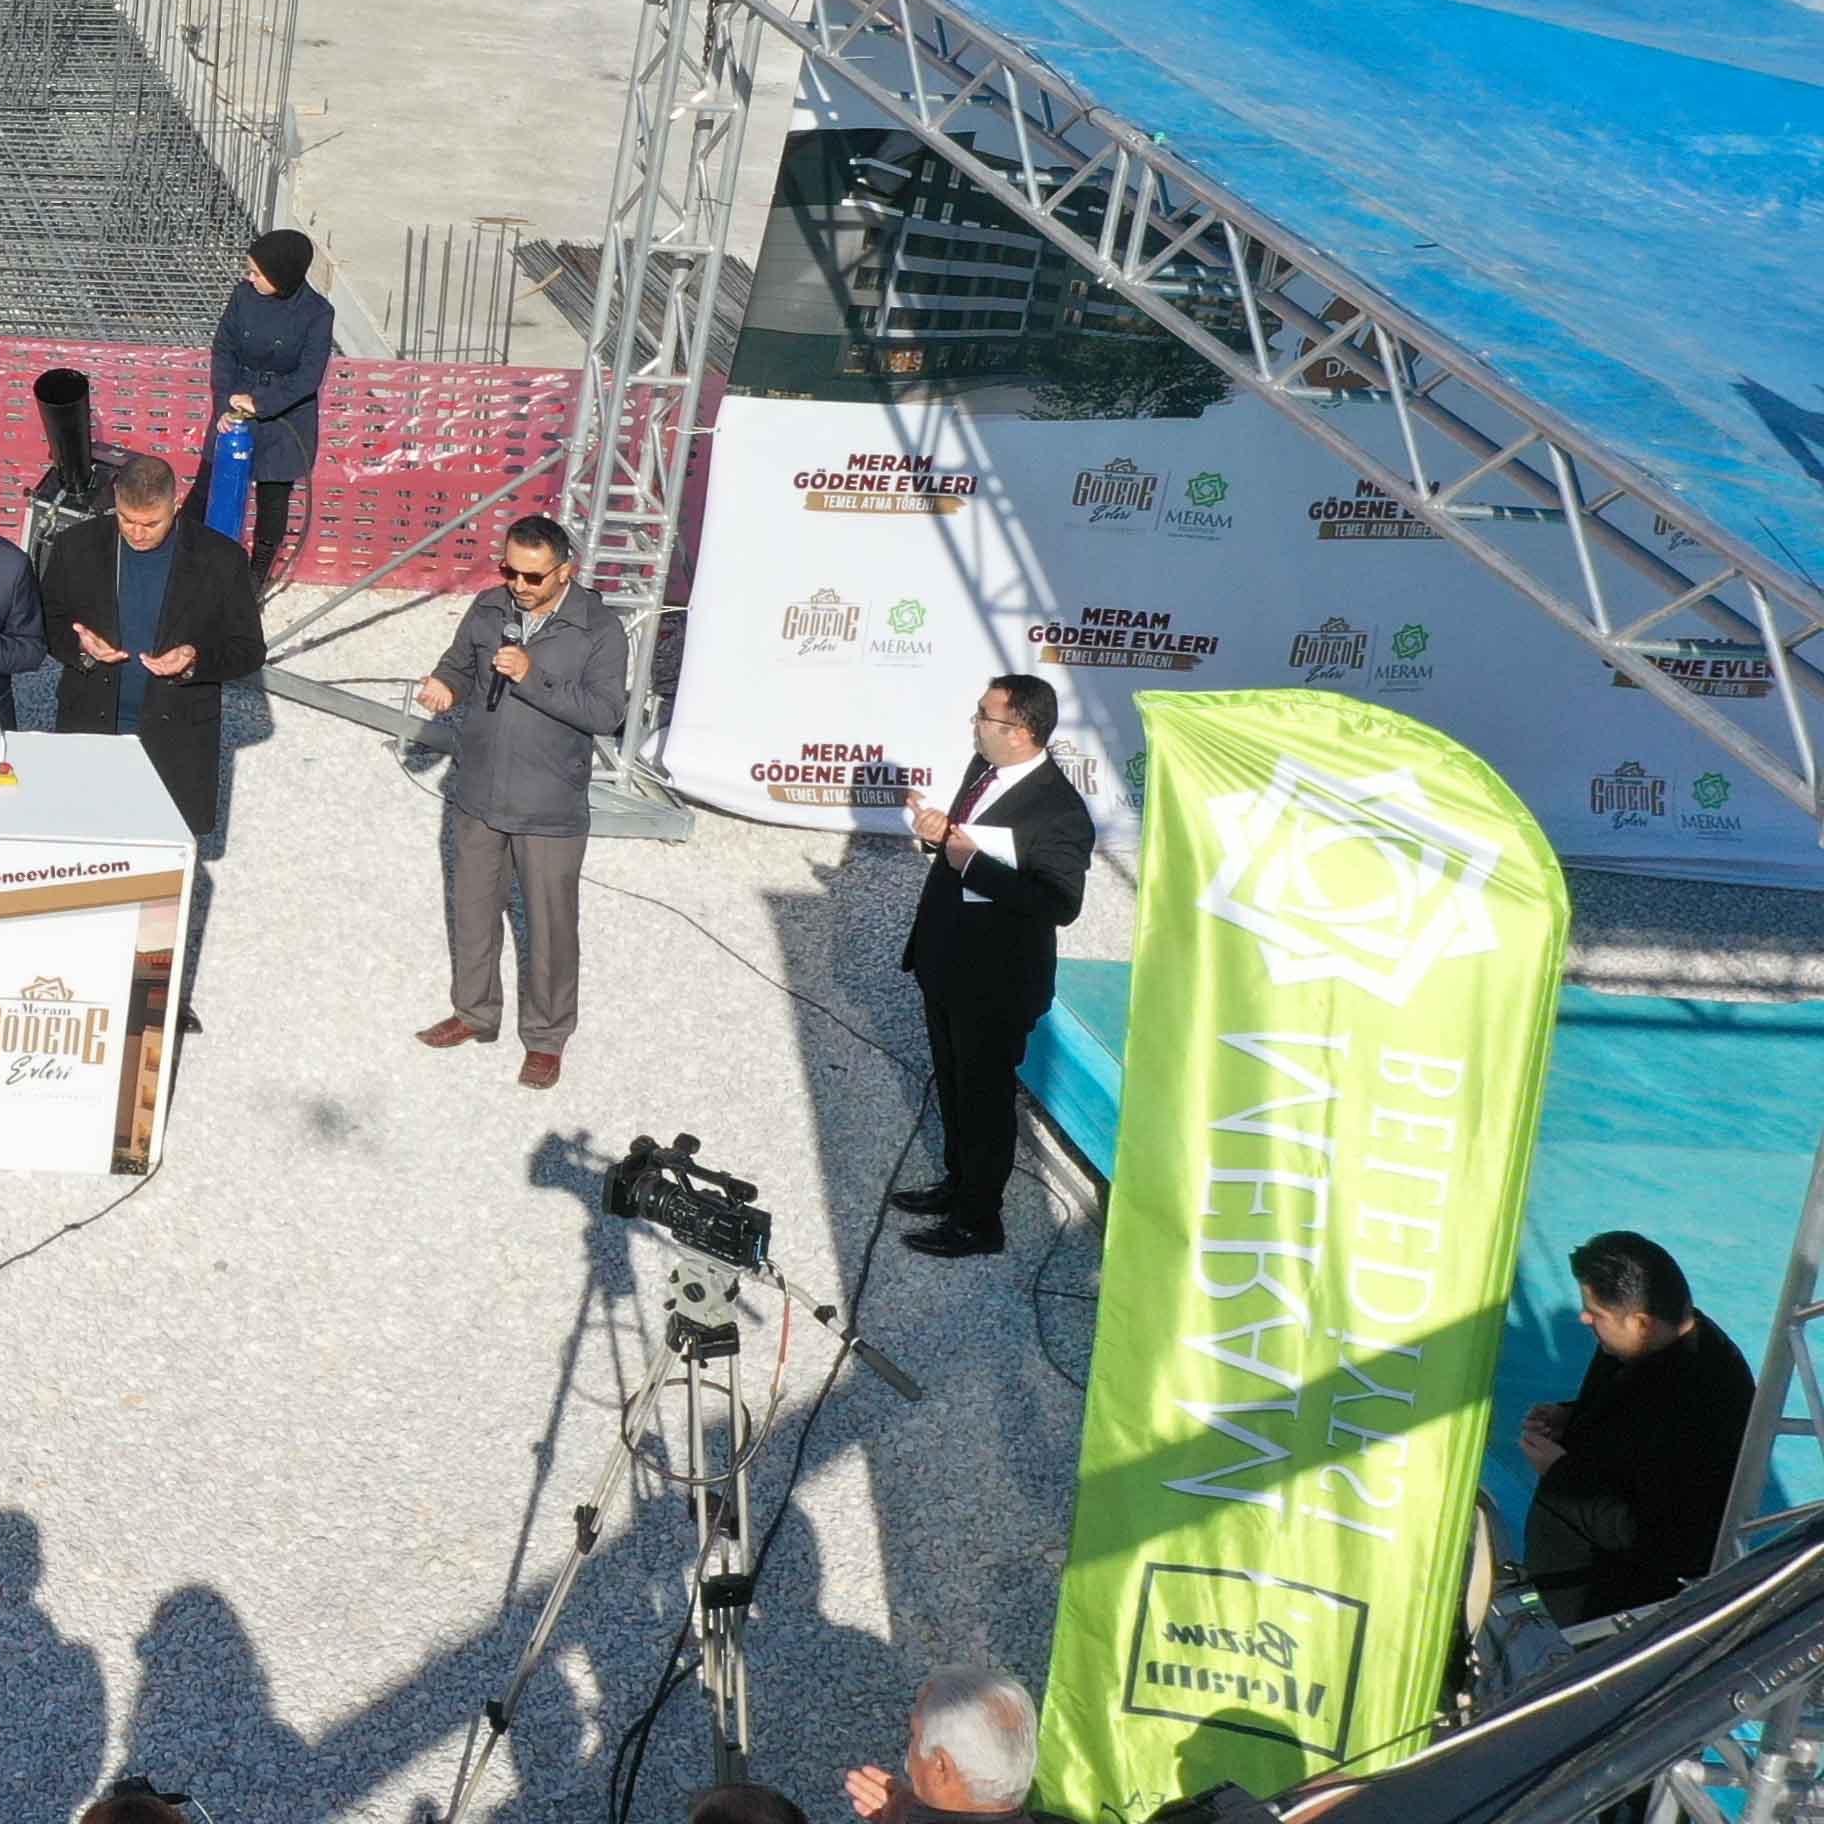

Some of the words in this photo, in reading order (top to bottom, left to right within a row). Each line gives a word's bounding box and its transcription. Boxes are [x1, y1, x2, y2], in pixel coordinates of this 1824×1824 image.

[847, 453, 933, 473] MERAM
[793, 469, 890, 492] GÖDENE
[823, 495, 857, 509] TEMEL
[860, 496, 892, 510] ATMA
[1309, 497, 1398, 521] GÖDENE
[1165, 511, 1232, 528] MERAM
[1081, 607, 1171, 630] MERAM
[1028, 622, 1127, 647] GÖDENE
[869, 640, 932, 655] MERAM
[1058, 650, 1093, 664] TEMEL
[1096, 651, 1127, 665] ATMA
[1375, 664, 1433, 679] MERAM
[801, 743, 883, 763] MERAM
[751, 760, 846, 784] GÖDENE
[783, 788, 818, 802] TEMEL
[822, 788, 850, 803] ATMA
[1680, 814, 1742, 829] MERAM
